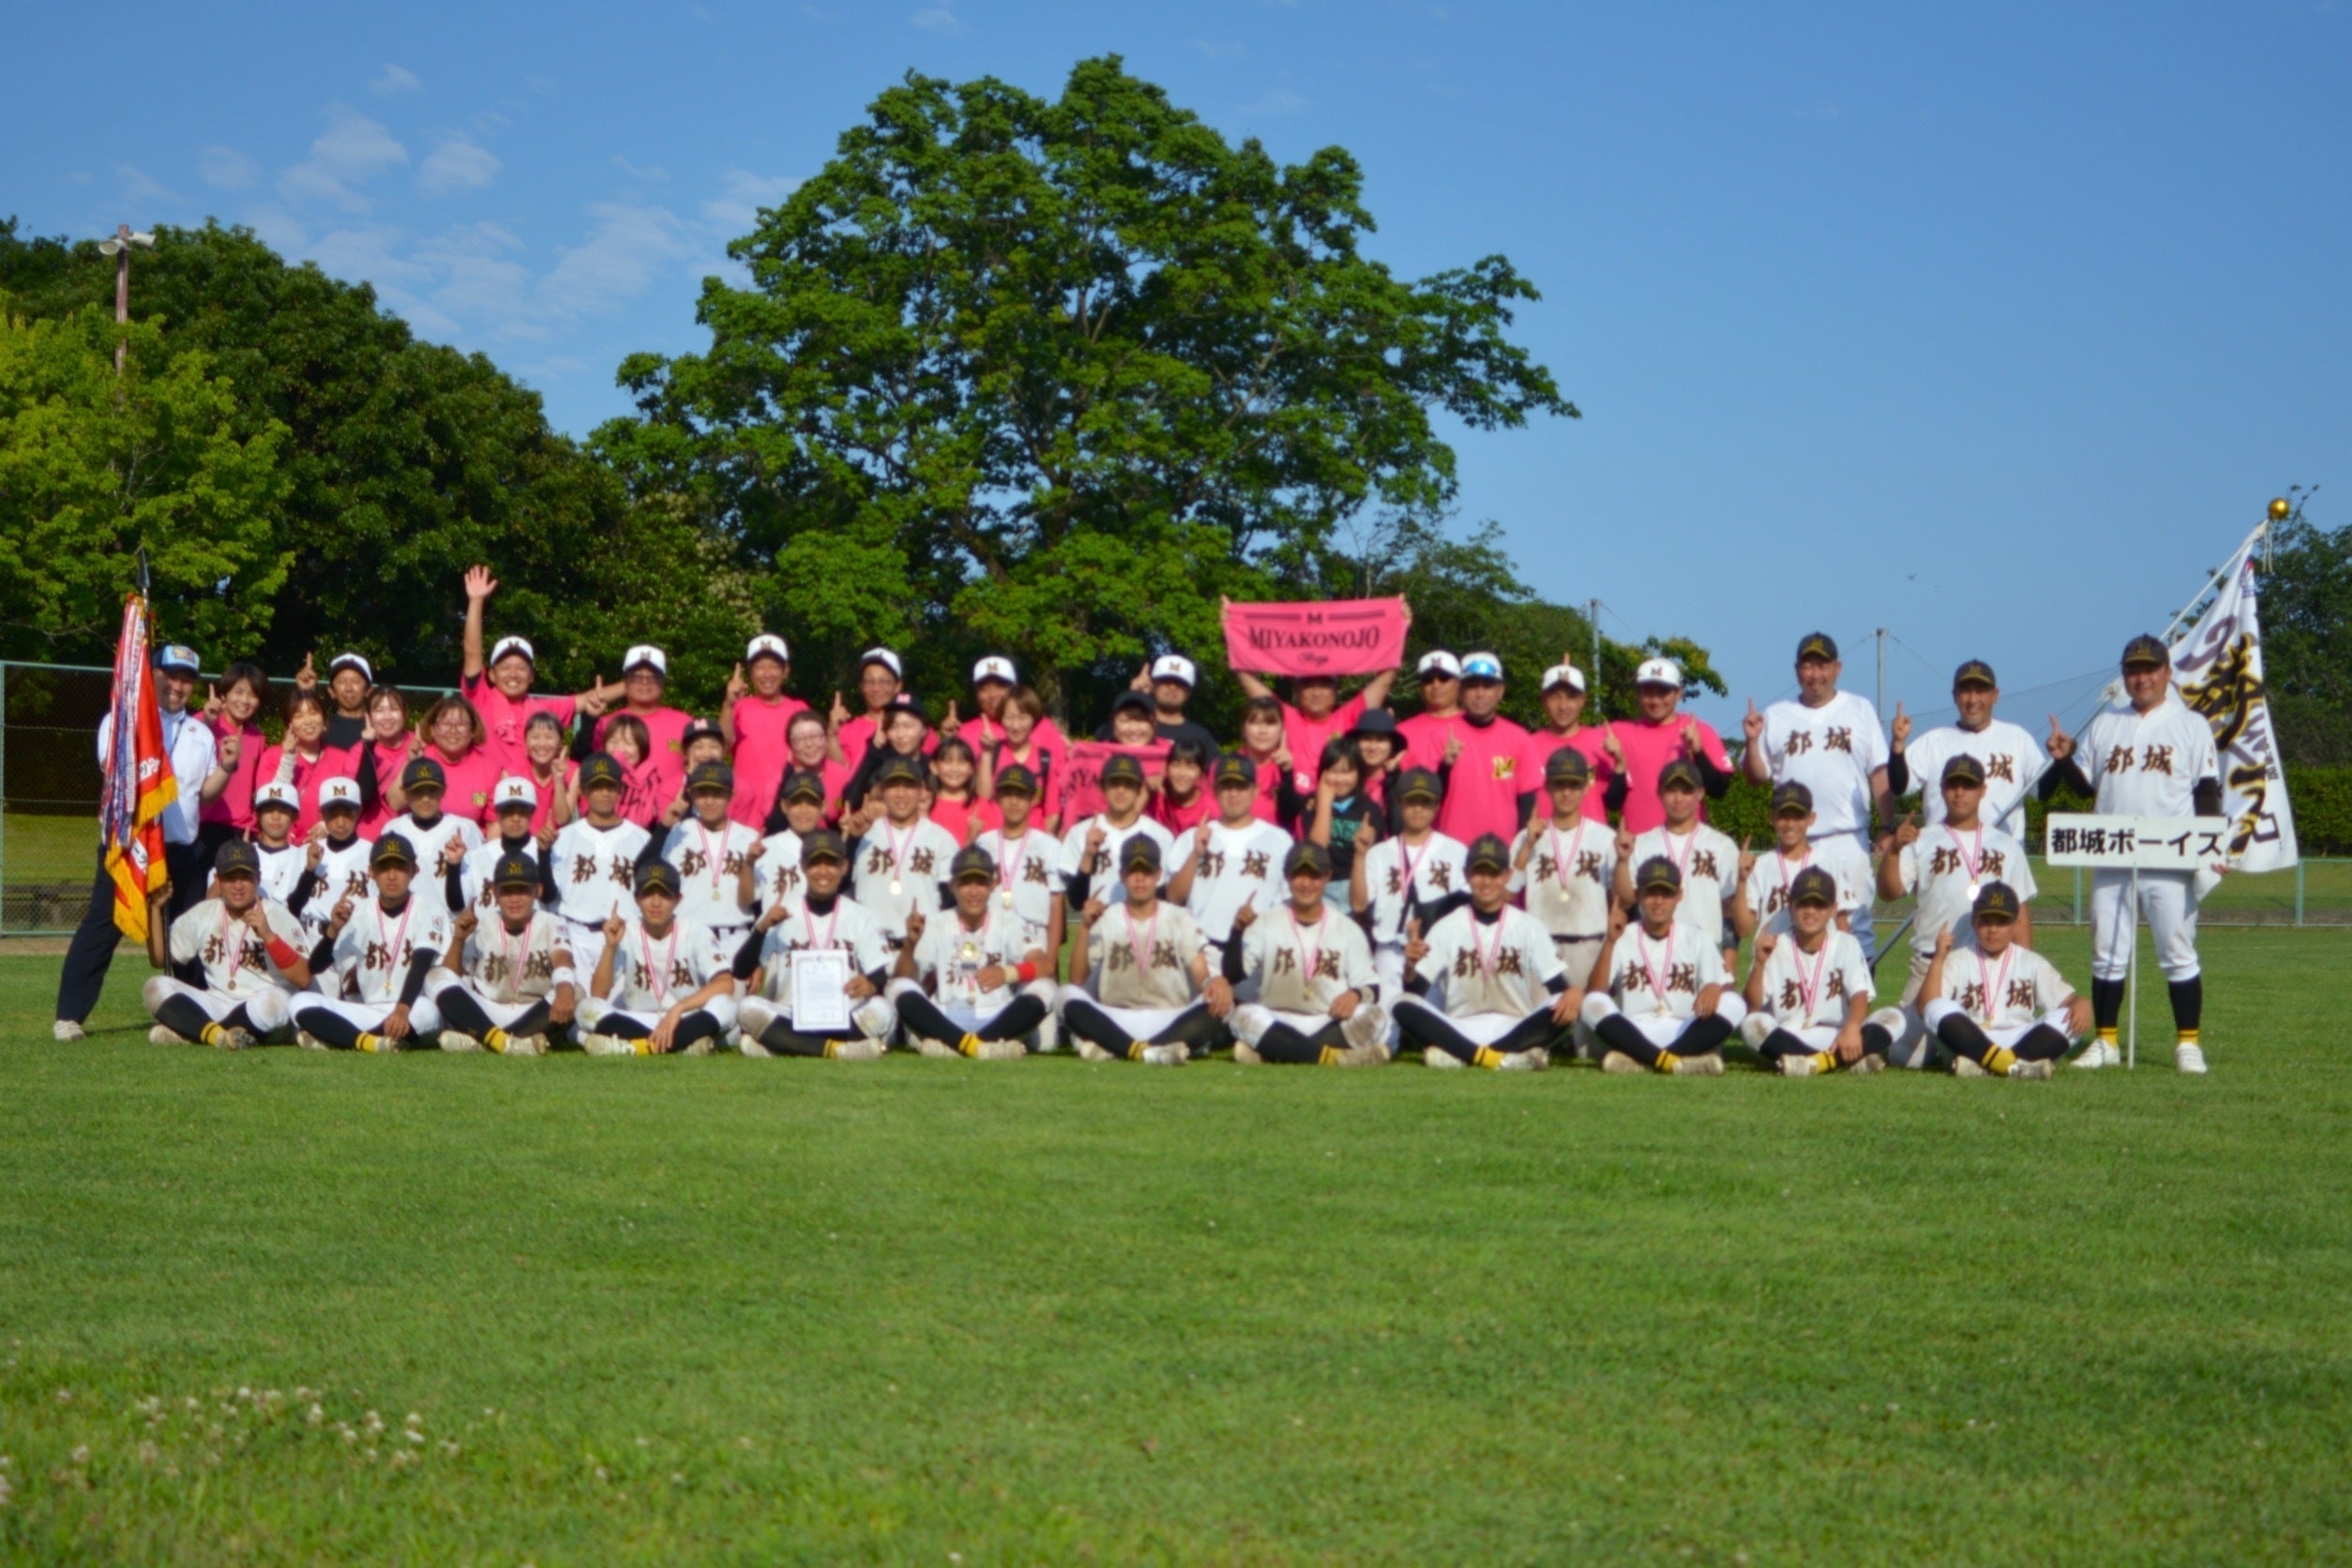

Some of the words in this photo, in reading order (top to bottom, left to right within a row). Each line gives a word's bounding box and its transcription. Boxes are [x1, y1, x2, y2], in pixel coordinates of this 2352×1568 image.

[1249, 626, 1380, 650] MIYAKONOJO
[1785, 726, 1853, 757] 都城
[1986, 752, 2014, 784] 城
[2104, 743, 2174, 776] 都城
[2051, 827, 2224, 856] 都城ボーイズ
[867, 846, 935, 875] 都城
[1199, 849, 1270, 880] 都城
[1691, 850, 1719, 882] 城
[1930, 845, 2006, 877] 都城
[204, 934, 268, 972] 都城
[484, 950, 553, 982] 都城
[1108, 941, 1179, 972] 都城
[1274, 945, 1340, 981] 都城
[1453, 946, 1523, 979] 都城
[1622, 959, 1696, 995] 都城
[1961, 979, 2033, 1012] 都城
